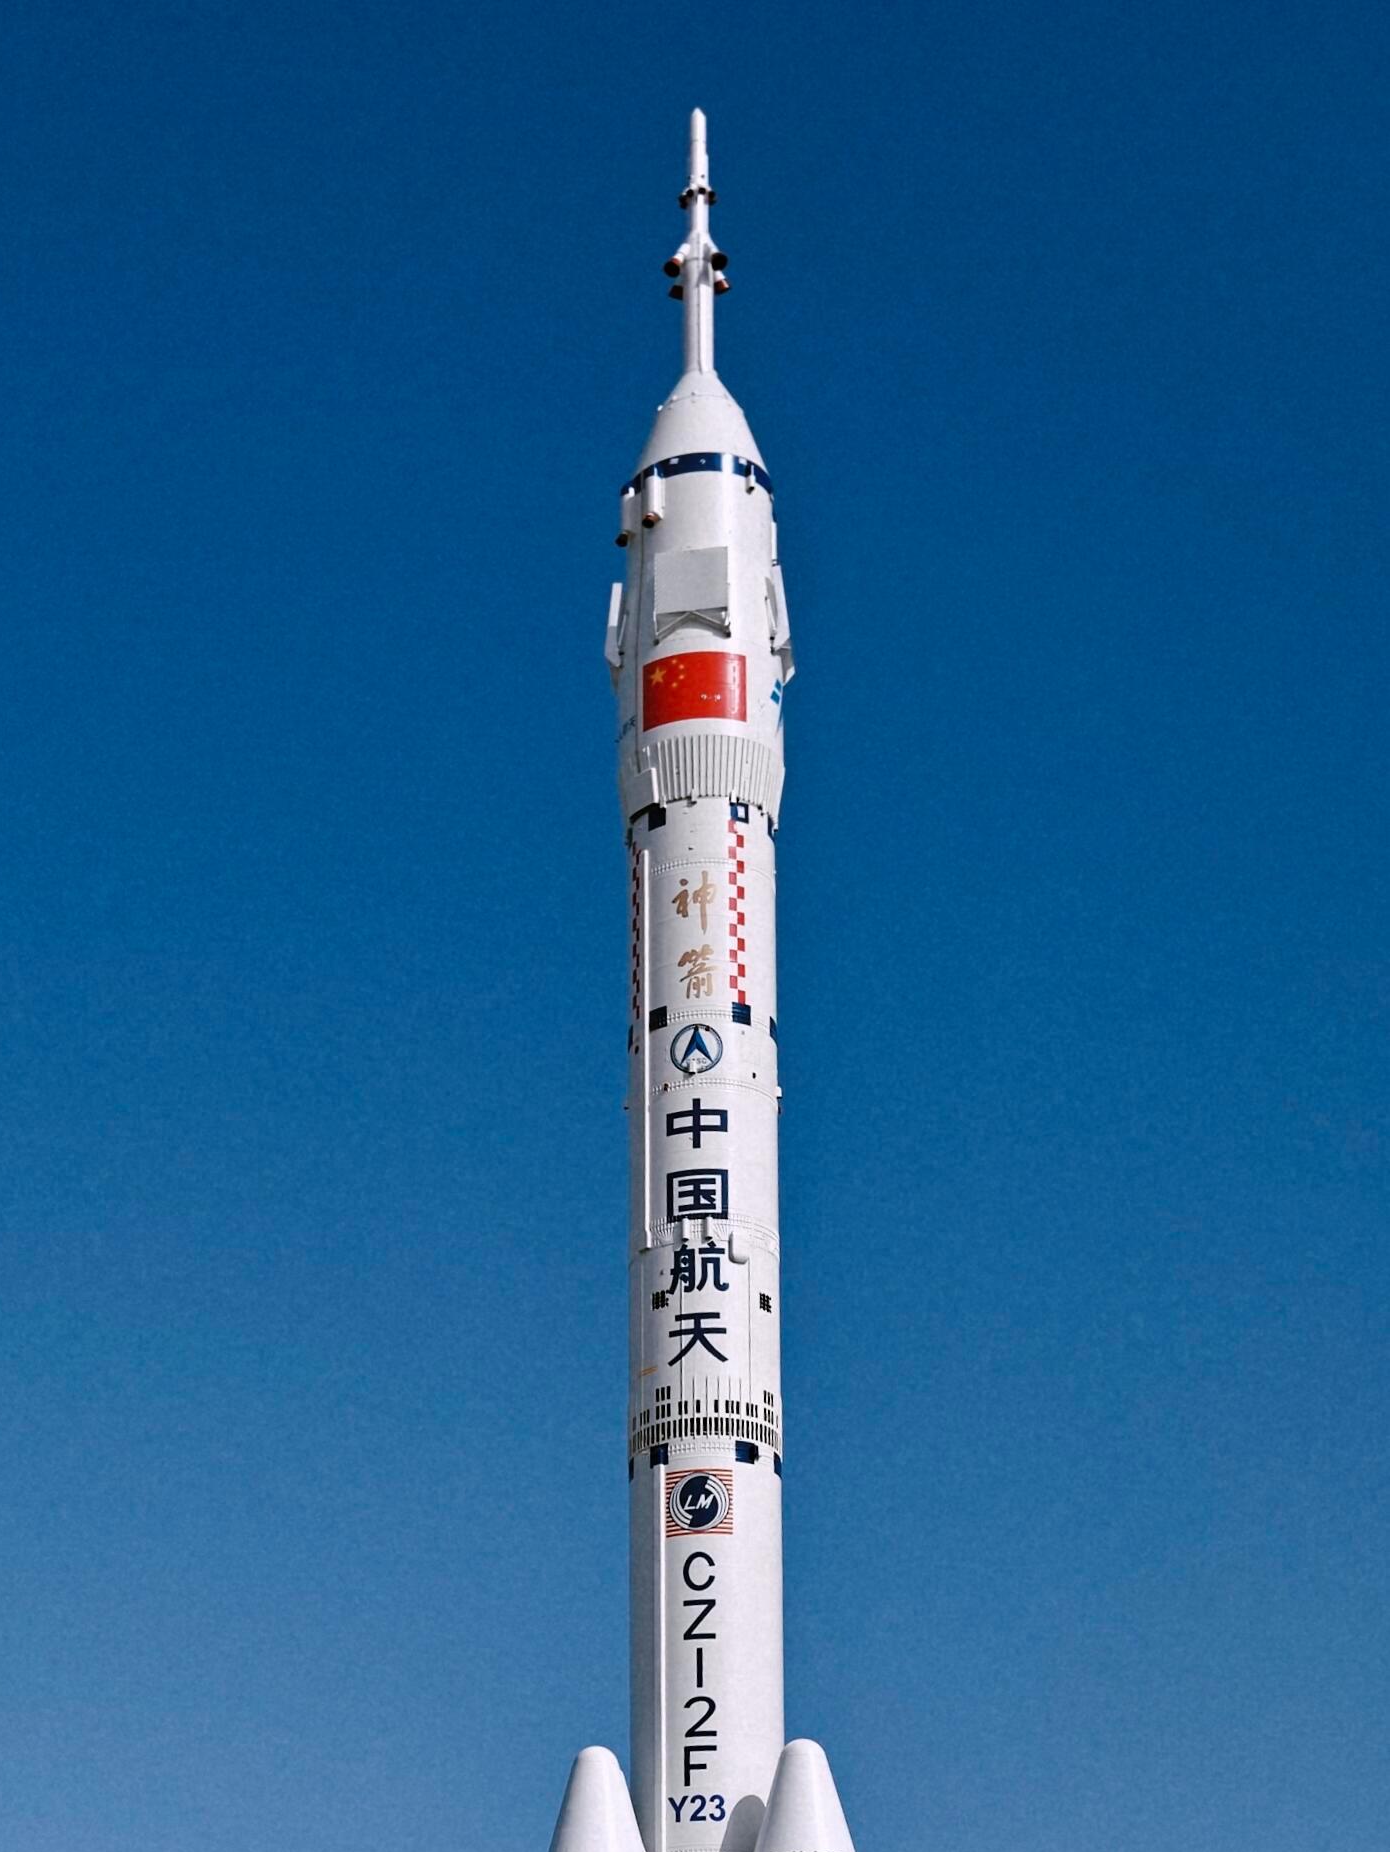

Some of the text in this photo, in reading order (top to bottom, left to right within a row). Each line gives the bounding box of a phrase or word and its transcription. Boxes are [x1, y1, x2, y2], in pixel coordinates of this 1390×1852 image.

[666, 1097, 729, 1367] 中国航天
[683, 1493, 715, 1510] LM
[668, 1794, 726, 1823] Y23
